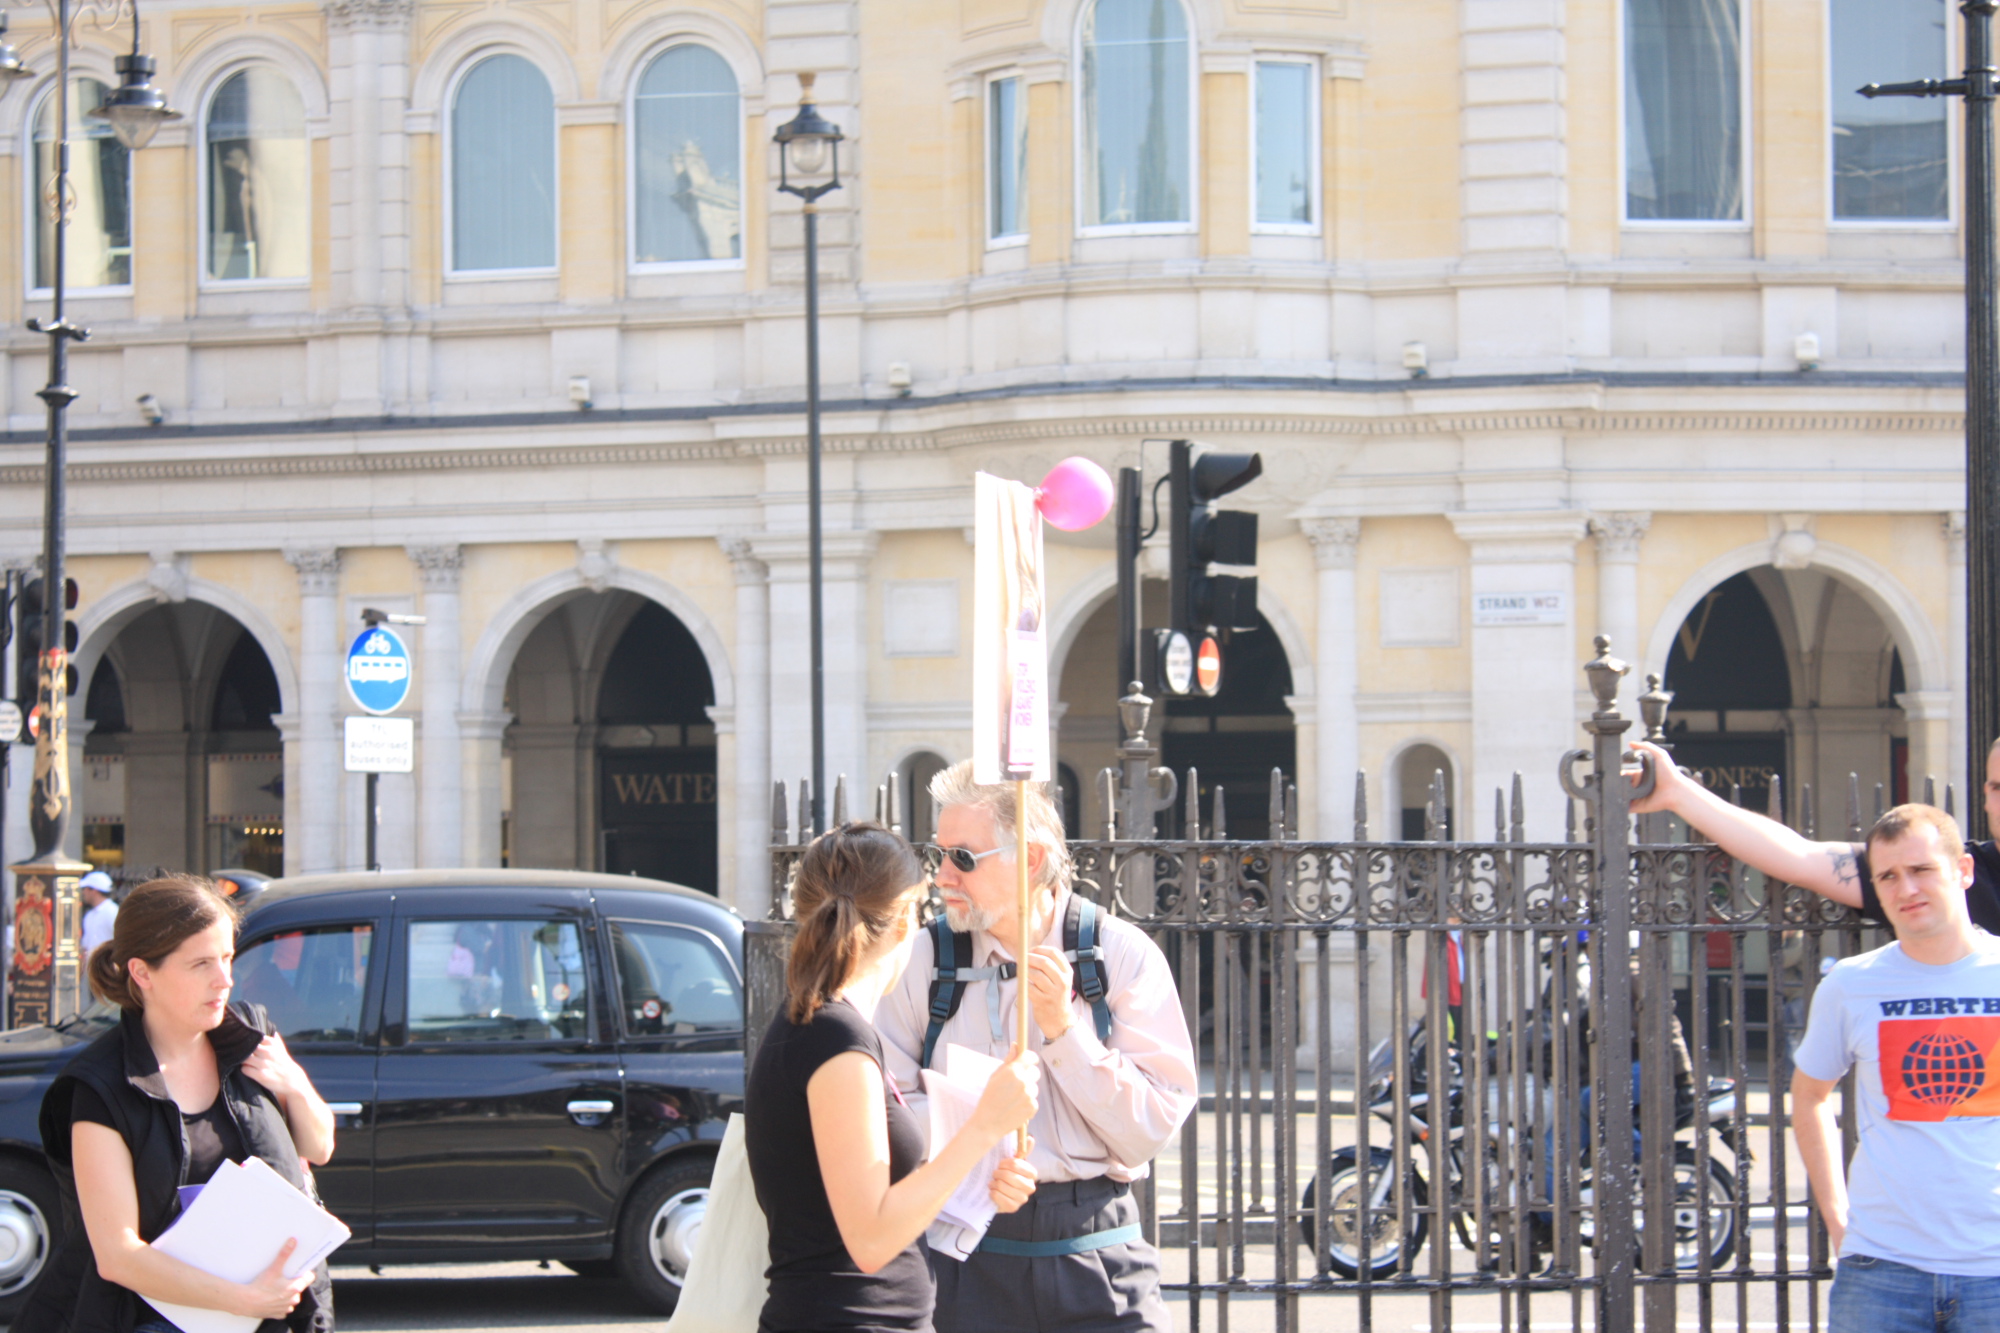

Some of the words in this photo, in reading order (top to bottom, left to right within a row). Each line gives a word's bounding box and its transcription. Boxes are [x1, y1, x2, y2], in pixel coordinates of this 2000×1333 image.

[1479, 598, 1526, 610] STRAND
[1533, 597, 1559, 609] WC2
[350, 740, 408, 750] authorised
[350, 754, 381, 764] buses
[386, 755, 408, 766] only
[612, 773, 716, 804] WATE
